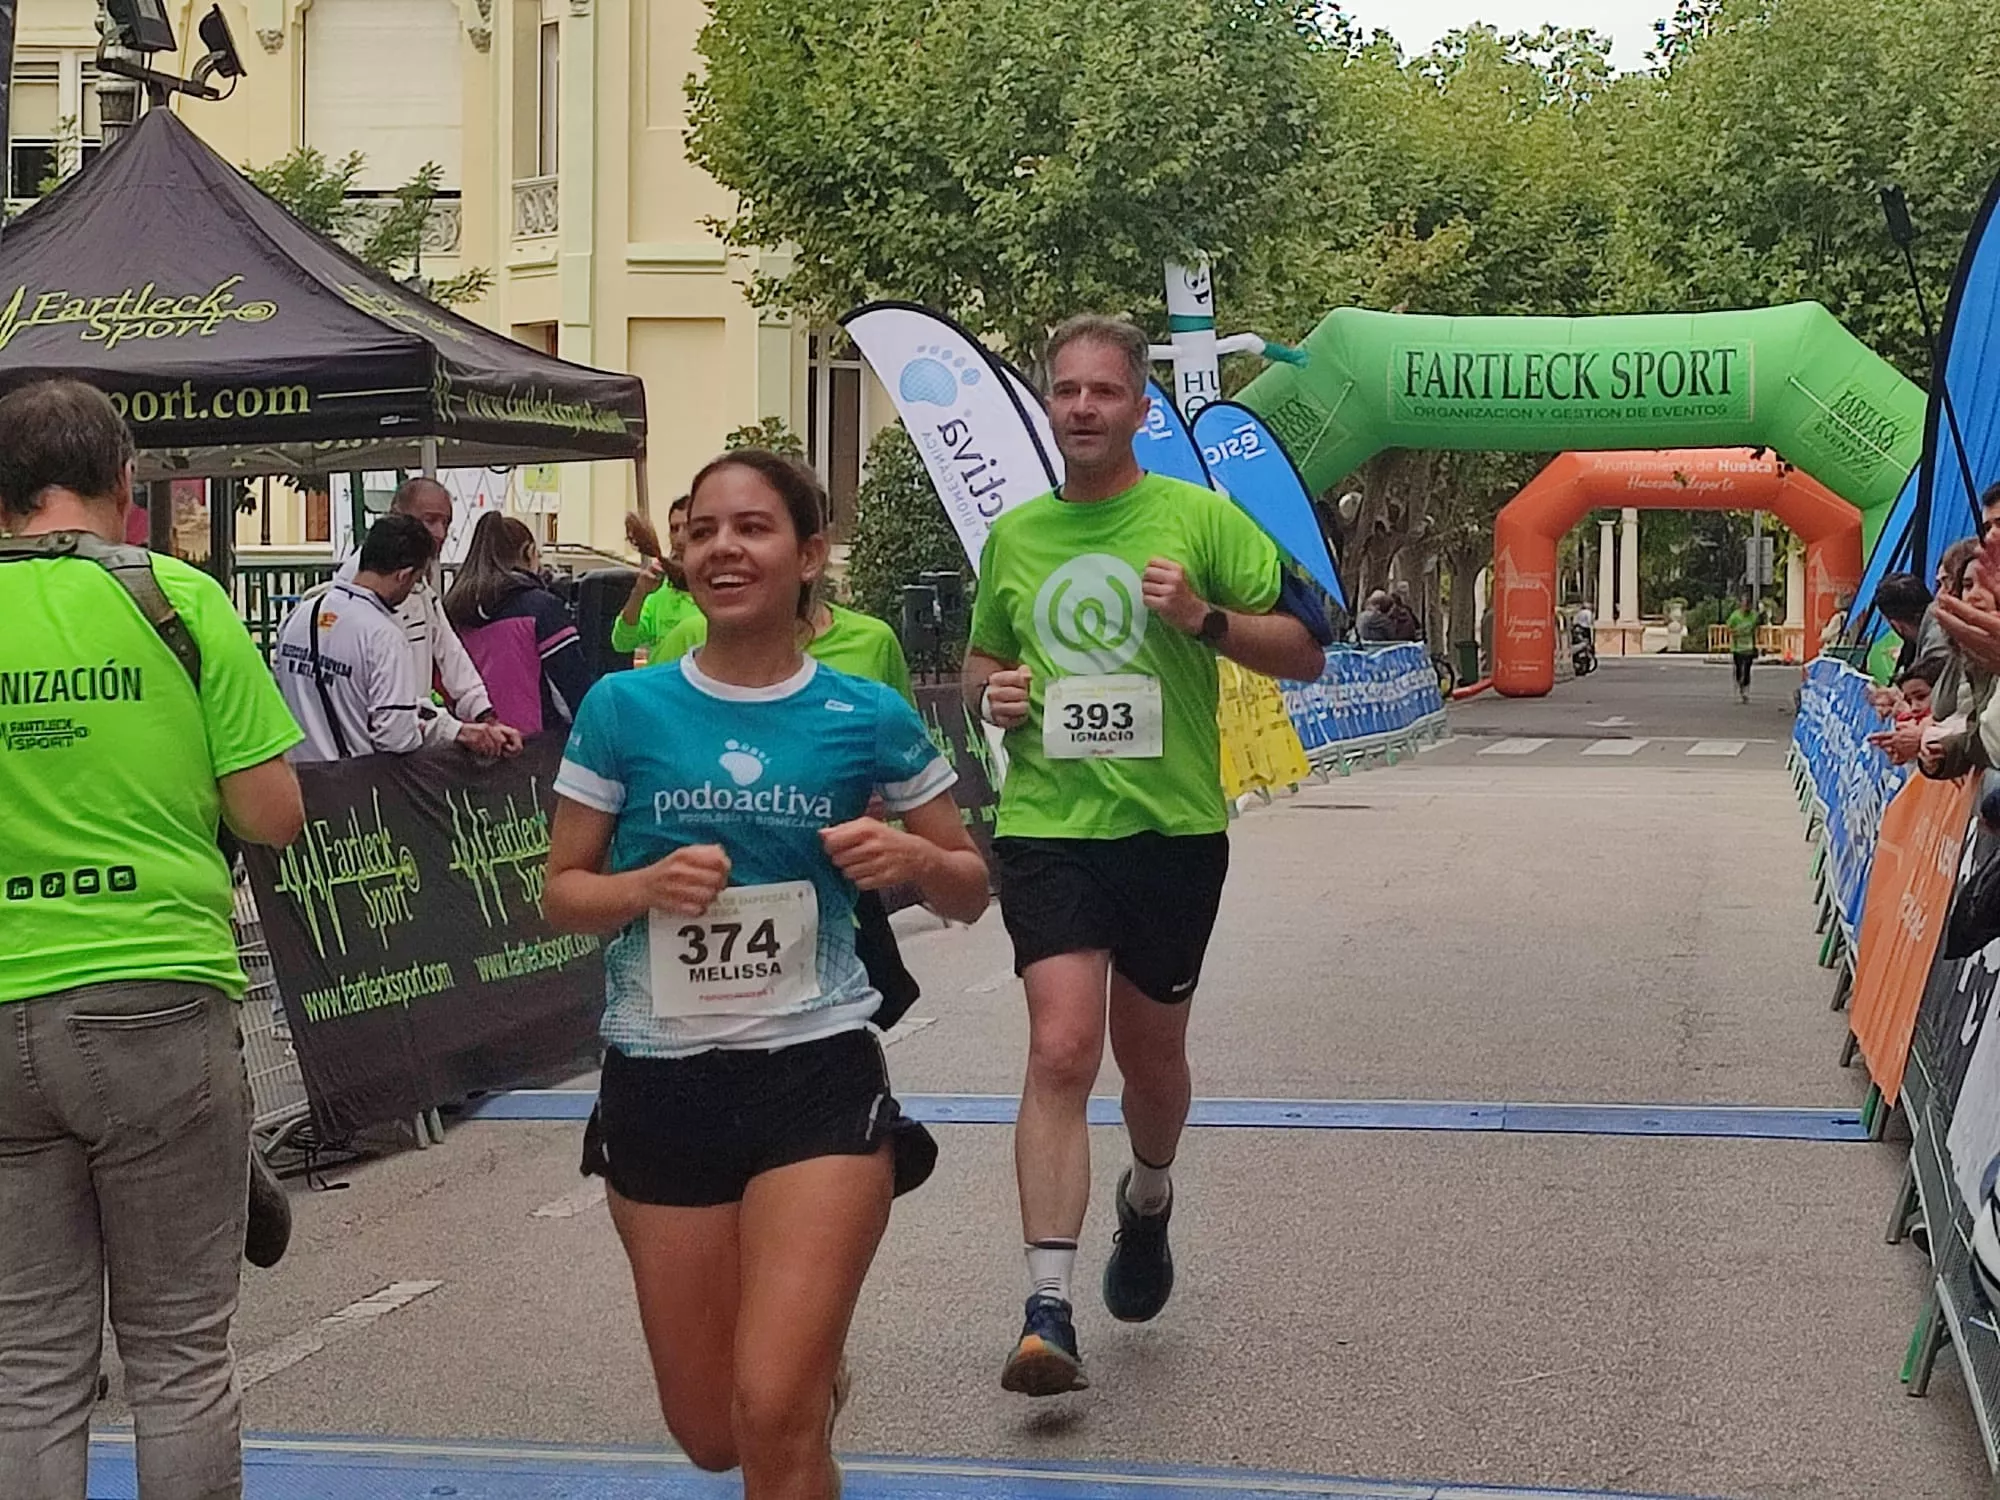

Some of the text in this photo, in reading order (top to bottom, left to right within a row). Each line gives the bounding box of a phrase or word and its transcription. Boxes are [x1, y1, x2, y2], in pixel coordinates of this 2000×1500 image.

[1404, 348, 1737, 400] FARTLECK SPORT
[1536, 408, 1548, 419] Y
[1626, 406, 1647, 418] DE
[1652, 404, 1727, 418] EVENTOS
[1697, 461, 1714, 471] de
[1718, 460, 1771, 473] Huesca
[0, 658, 142, 705] NIZACIÓN
[1063, 702, 1134, 730] 393
[1071, 731, 1134, 742] IGNACIO
[654, 780, 832, 825] podoactiva
[677, 918, 781, 965] 374
[689, 962, 782, 983] MELISSA
